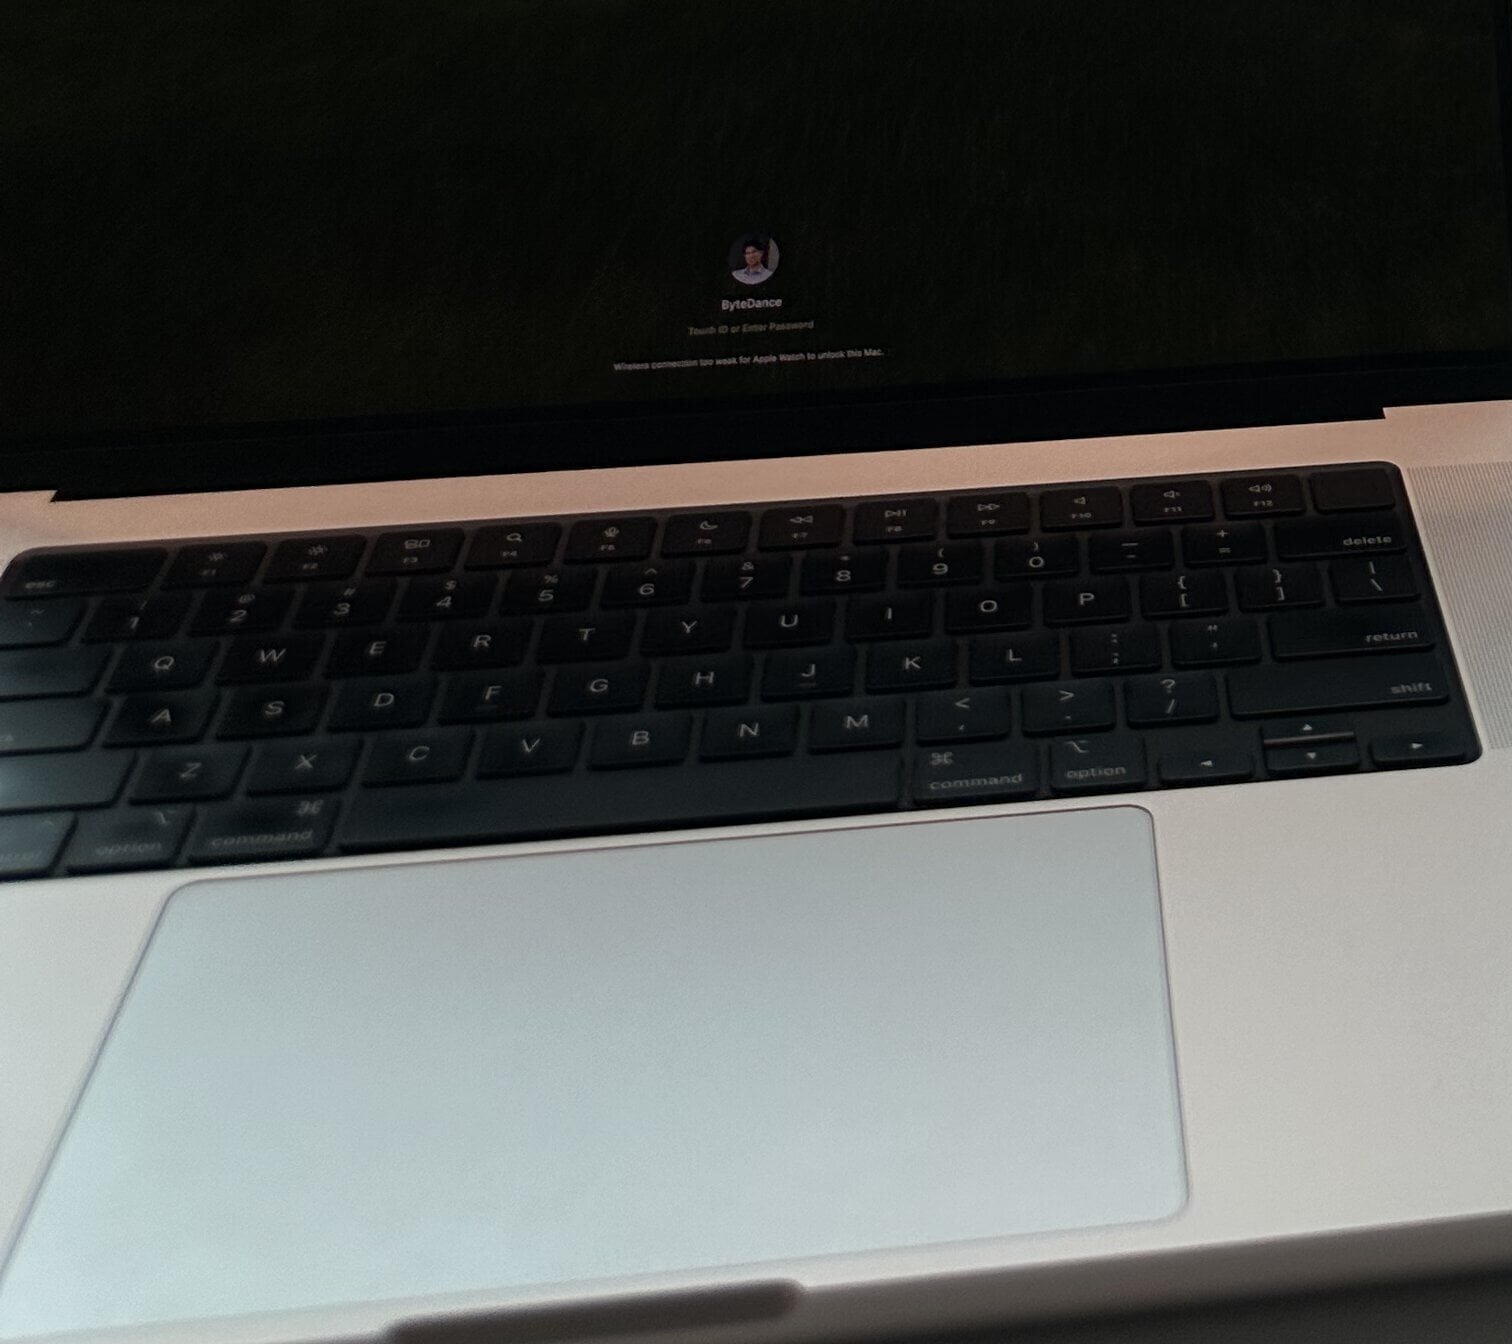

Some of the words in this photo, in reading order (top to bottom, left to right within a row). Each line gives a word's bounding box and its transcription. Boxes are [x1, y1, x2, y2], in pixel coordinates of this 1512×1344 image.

[721, 297, 782, 312] ByteDance
[688, 325, 716, 336] Touch
[718, 324, 729, 334] ID
[730, 325, 740, 333] or
[742, 323, 767, 333] Enter
[769, 320, 814, 331] Password
[738, 356, 751, 365] for
[753, 354, 777, 365] Apple
[779, 352, 806, 362] Watch
[807, 352, 816, 361] to
[817, 350, 846, 360] unlock
[847, 349, 862, 358] this
[1343, 534, 1392, 546] delete
[836, 570, 851, 582] 8
[932, 563, 948, 575] 9
[25, 580, 57, 589] esc
[740, 576, 754, 588] 7
[540, 589, 554, 602] 5
[640, 584, 655, 596] 6
[436, 596, 453, 609] 4
[980, 600, 998, 612] O
[1080, 592, 1095, 606] P
[230, 609, 247, 623] 2
[336, 602, 350, 617] 3
[130, 616, 140, 630] 1
[682, 620, 698, 633] Y
[780, 614, 798, 628] U
[473, 634, 492, 648] R
[580, 628, 596, 641] T
[1365, 631, 1418, 643] return
[369, 640, 387, 656] E
[260, 648, 287, 663] W
[1008, 649, 1022, 662] L
[154, 656, 175, 670] Q
[905, 656, 920, 670] K
[801, 664, 816, 678] J
[590, 679, 608, 693] G
[694, 672, 714, 686] H
[485, 686, 502, 701] F
[1162, 679, 1176, 694] ?
[1391, 682, 1432, 694] shift
[374, 693, 394, 708] D
[265, 700, 286, 716] S
[151, 708, 172, 723] A
[846, 714, 869, 728] M
[740, 723, 759, 737] N
[522, 738, 540, 752] V
[631, 730, 650, 746] B
[408, 746, 430, 761] C
[296, 754, 318, 769] X
[181, 762, 202, 778] Z
[1066, 765, 1127, 779] option
[929, 774, 1022, 790] command
[211, 830, 312, 847] command
